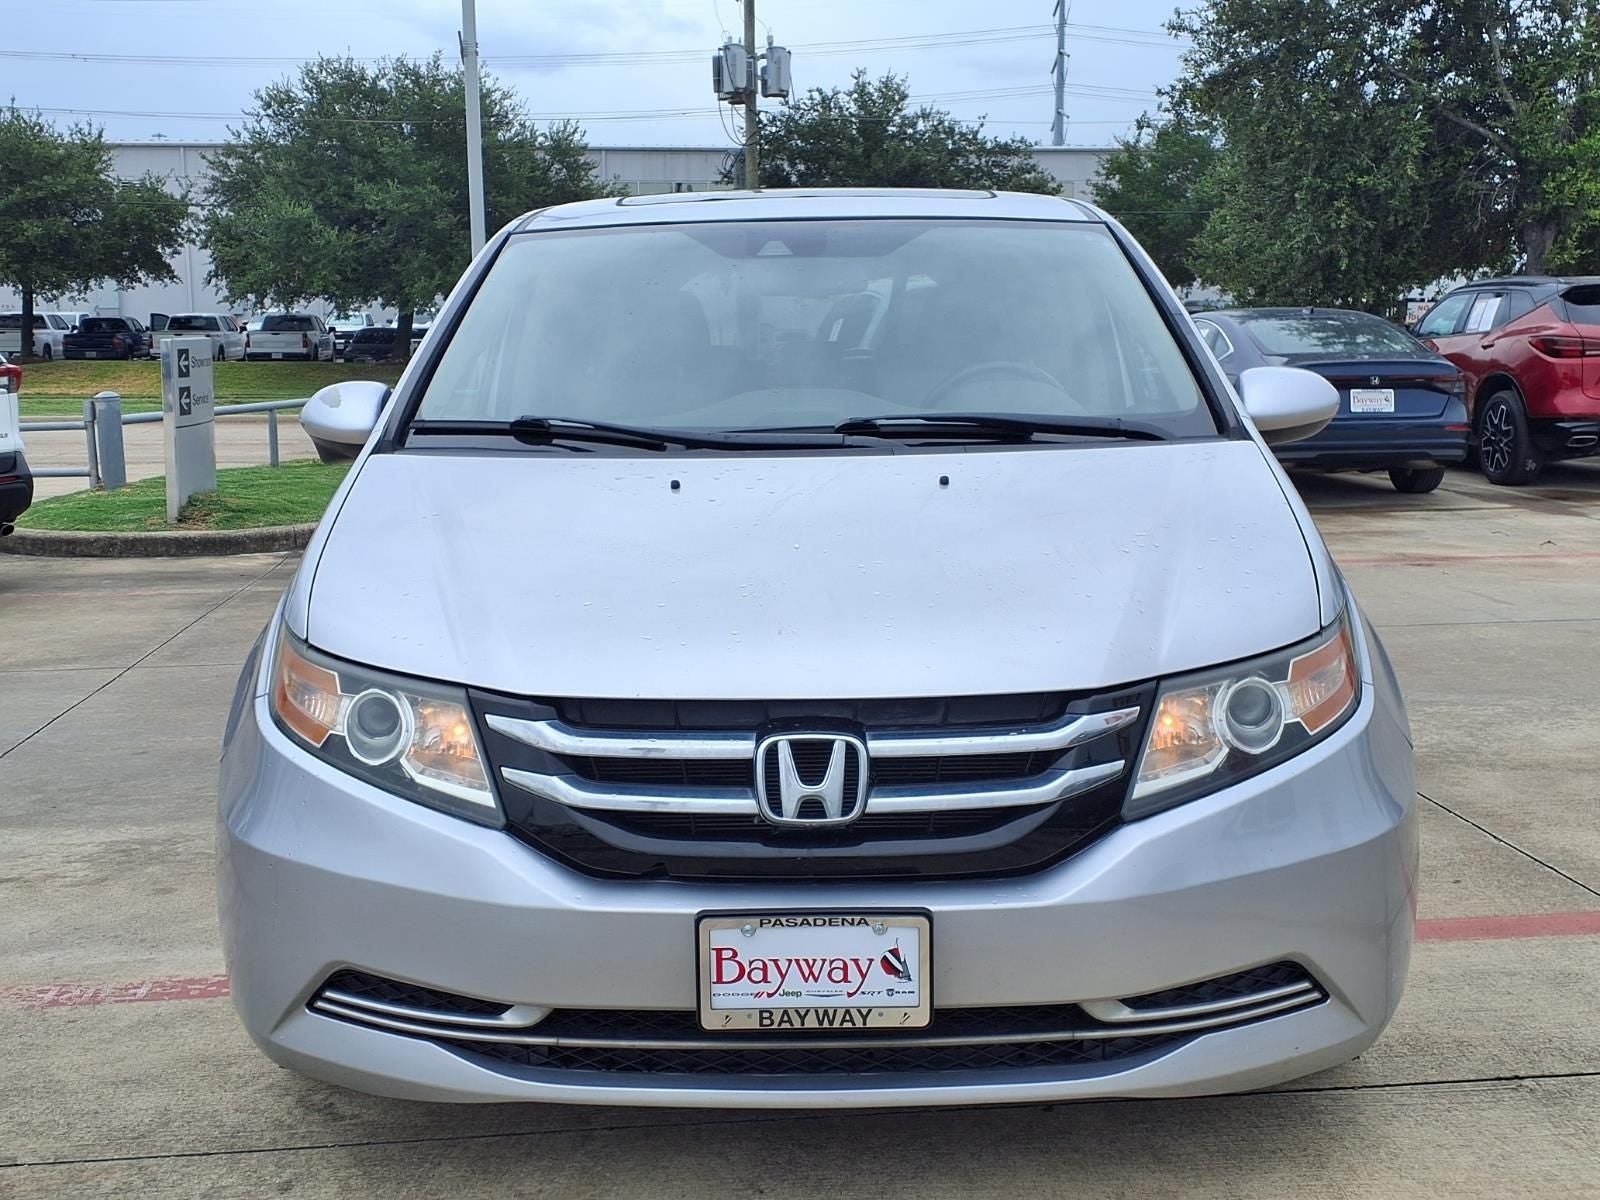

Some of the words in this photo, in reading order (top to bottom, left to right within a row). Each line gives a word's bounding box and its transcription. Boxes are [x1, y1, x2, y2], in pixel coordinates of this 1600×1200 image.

[192, 393, 208, 406] Service
[759, 917, 870, 928] PASADENA
[711, 947, 875, 998] Bayway
[778, 989, 802, 998] Jeep
[758, 1009, 873, 1027] BAYWAY
